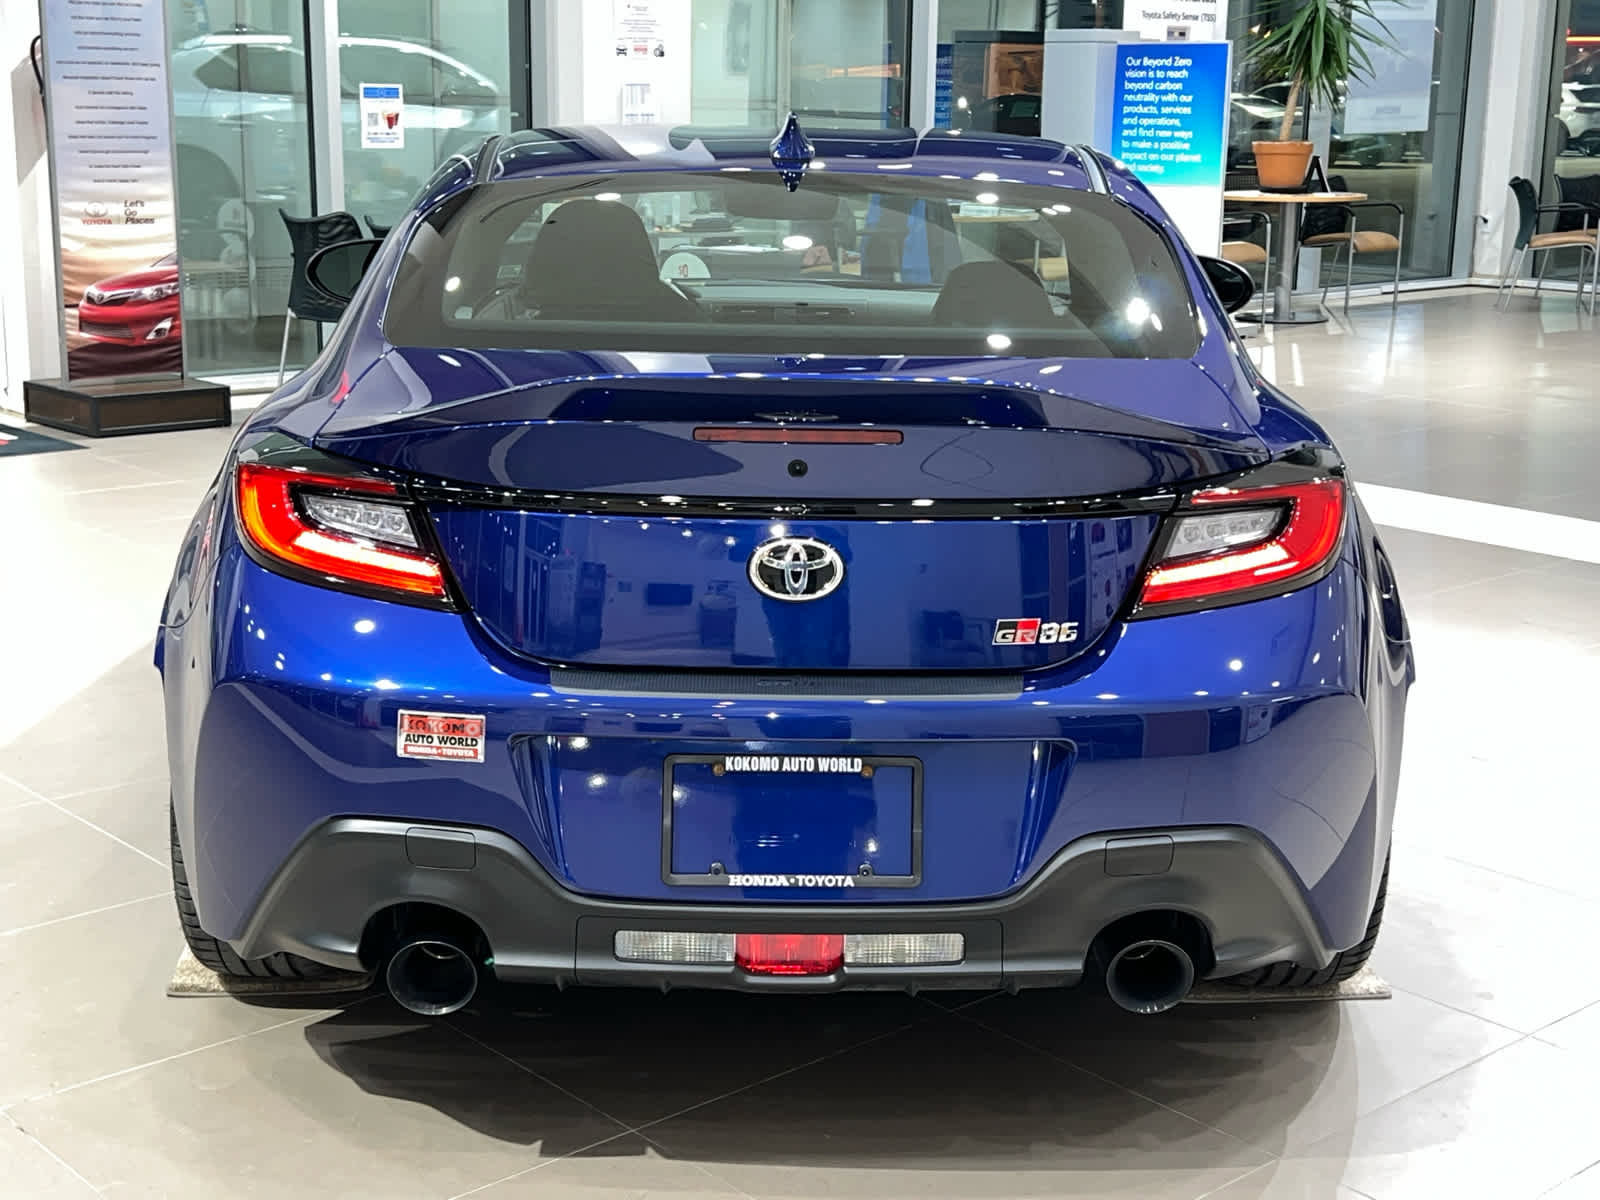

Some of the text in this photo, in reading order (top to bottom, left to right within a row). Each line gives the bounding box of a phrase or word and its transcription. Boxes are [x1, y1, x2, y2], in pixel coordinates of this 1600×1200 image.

[1141, 10, 1161, 20] Toyota
[1162, 11, 1181, 21] Safety
[1182, 12, 1199, 21] Sense
[1126, 56, 1192, 68] Our Beyond Zero
[1125, 69, 1189, 78] vision is to reach
[1124, 80, 1183, 92] beyond carbon
[1123, 93, 1160, 104] neutrality
[1161, 93, 1178, 102] with
[1123, 104, 1192, 115] products, services
[1123, 115, 1182, 127] and operations,
[1122, 127, 1193, 140] and find new ways
[1121, 139, 1130, 148] to
[1131, 139, 1153, 148] make
[1160, 140, 1191, 151] positive
[1121, 151, 1147, 162] impact
[1175, 153, 1202, 163] planet
[124, 199, 145, 207] Let's
[124, 208, 138, 217] Go
[125, 216, 155, 225] Places
[405, 733, 478, 747] AUTO WORLD
[725, 756, 863, 773] KOKOMO AUTO WORLD
